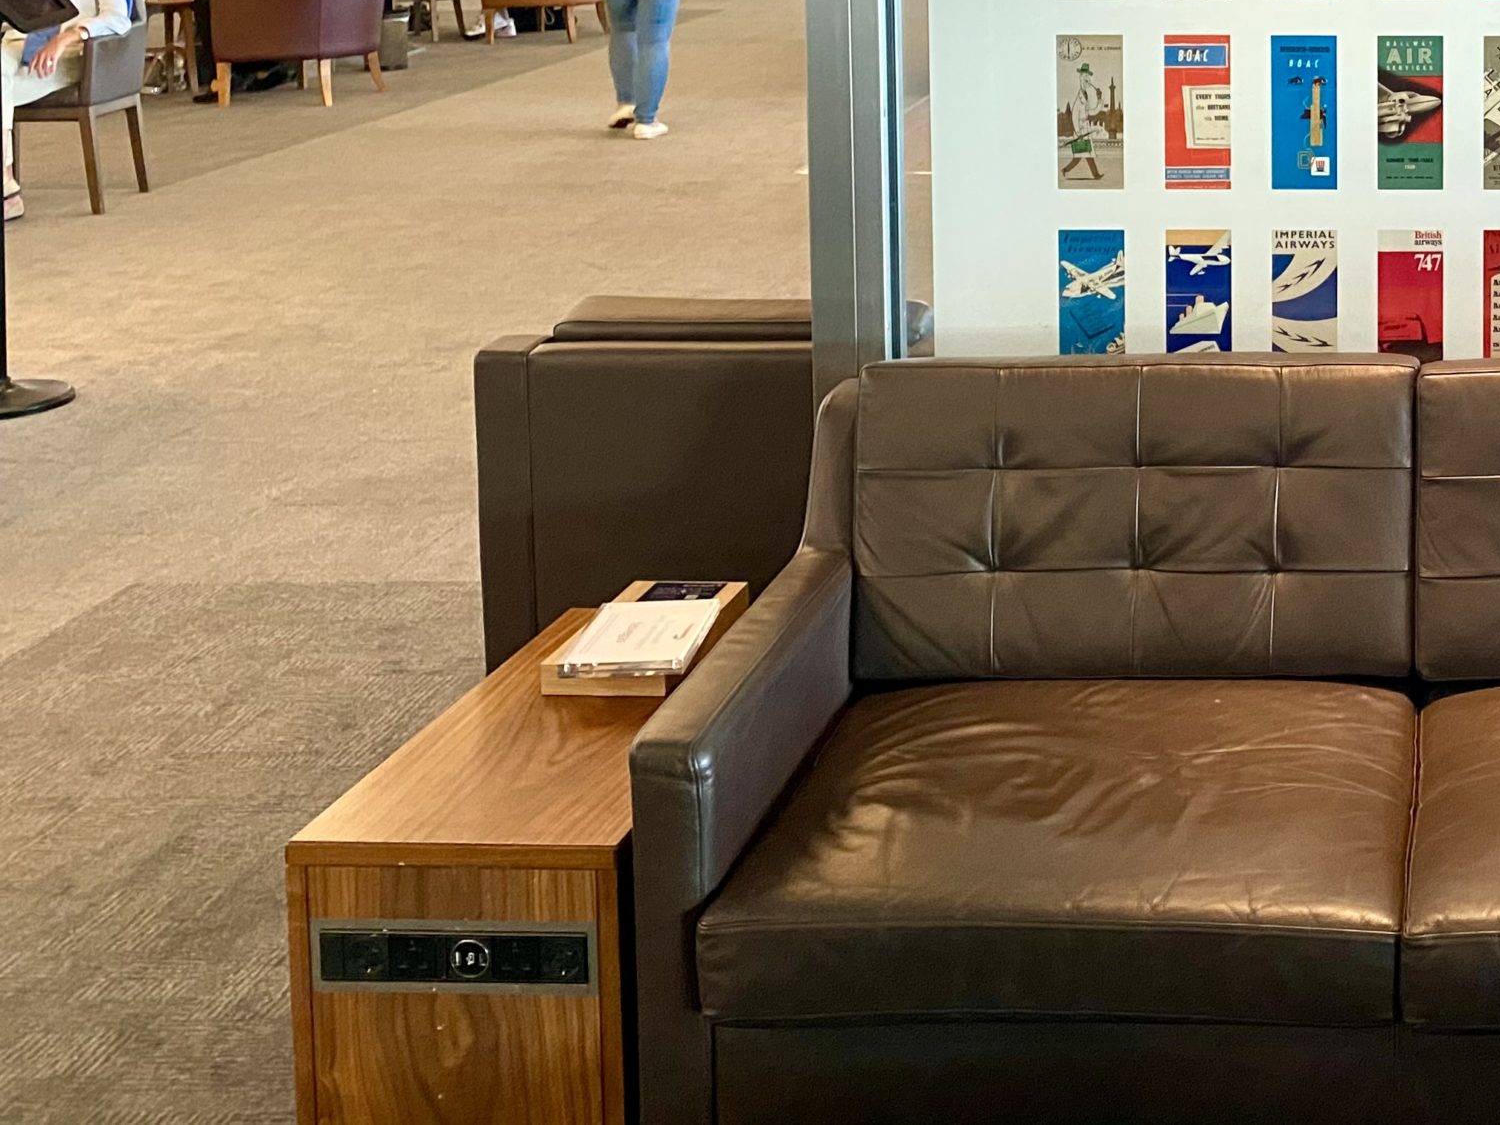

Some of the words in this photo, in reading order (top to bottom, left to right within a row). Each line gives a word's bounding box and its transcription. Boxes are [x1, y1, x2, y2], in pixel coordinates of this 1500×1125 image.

[1386, 48, 1433, 64] AIR
[1275, 231, 1335, 239] IMPERIAL
[1414, 231, 1442, 239] British
[1274, 240, 1335, 249] AIRWAYS
[1414, 253, 1442, 271] 747
